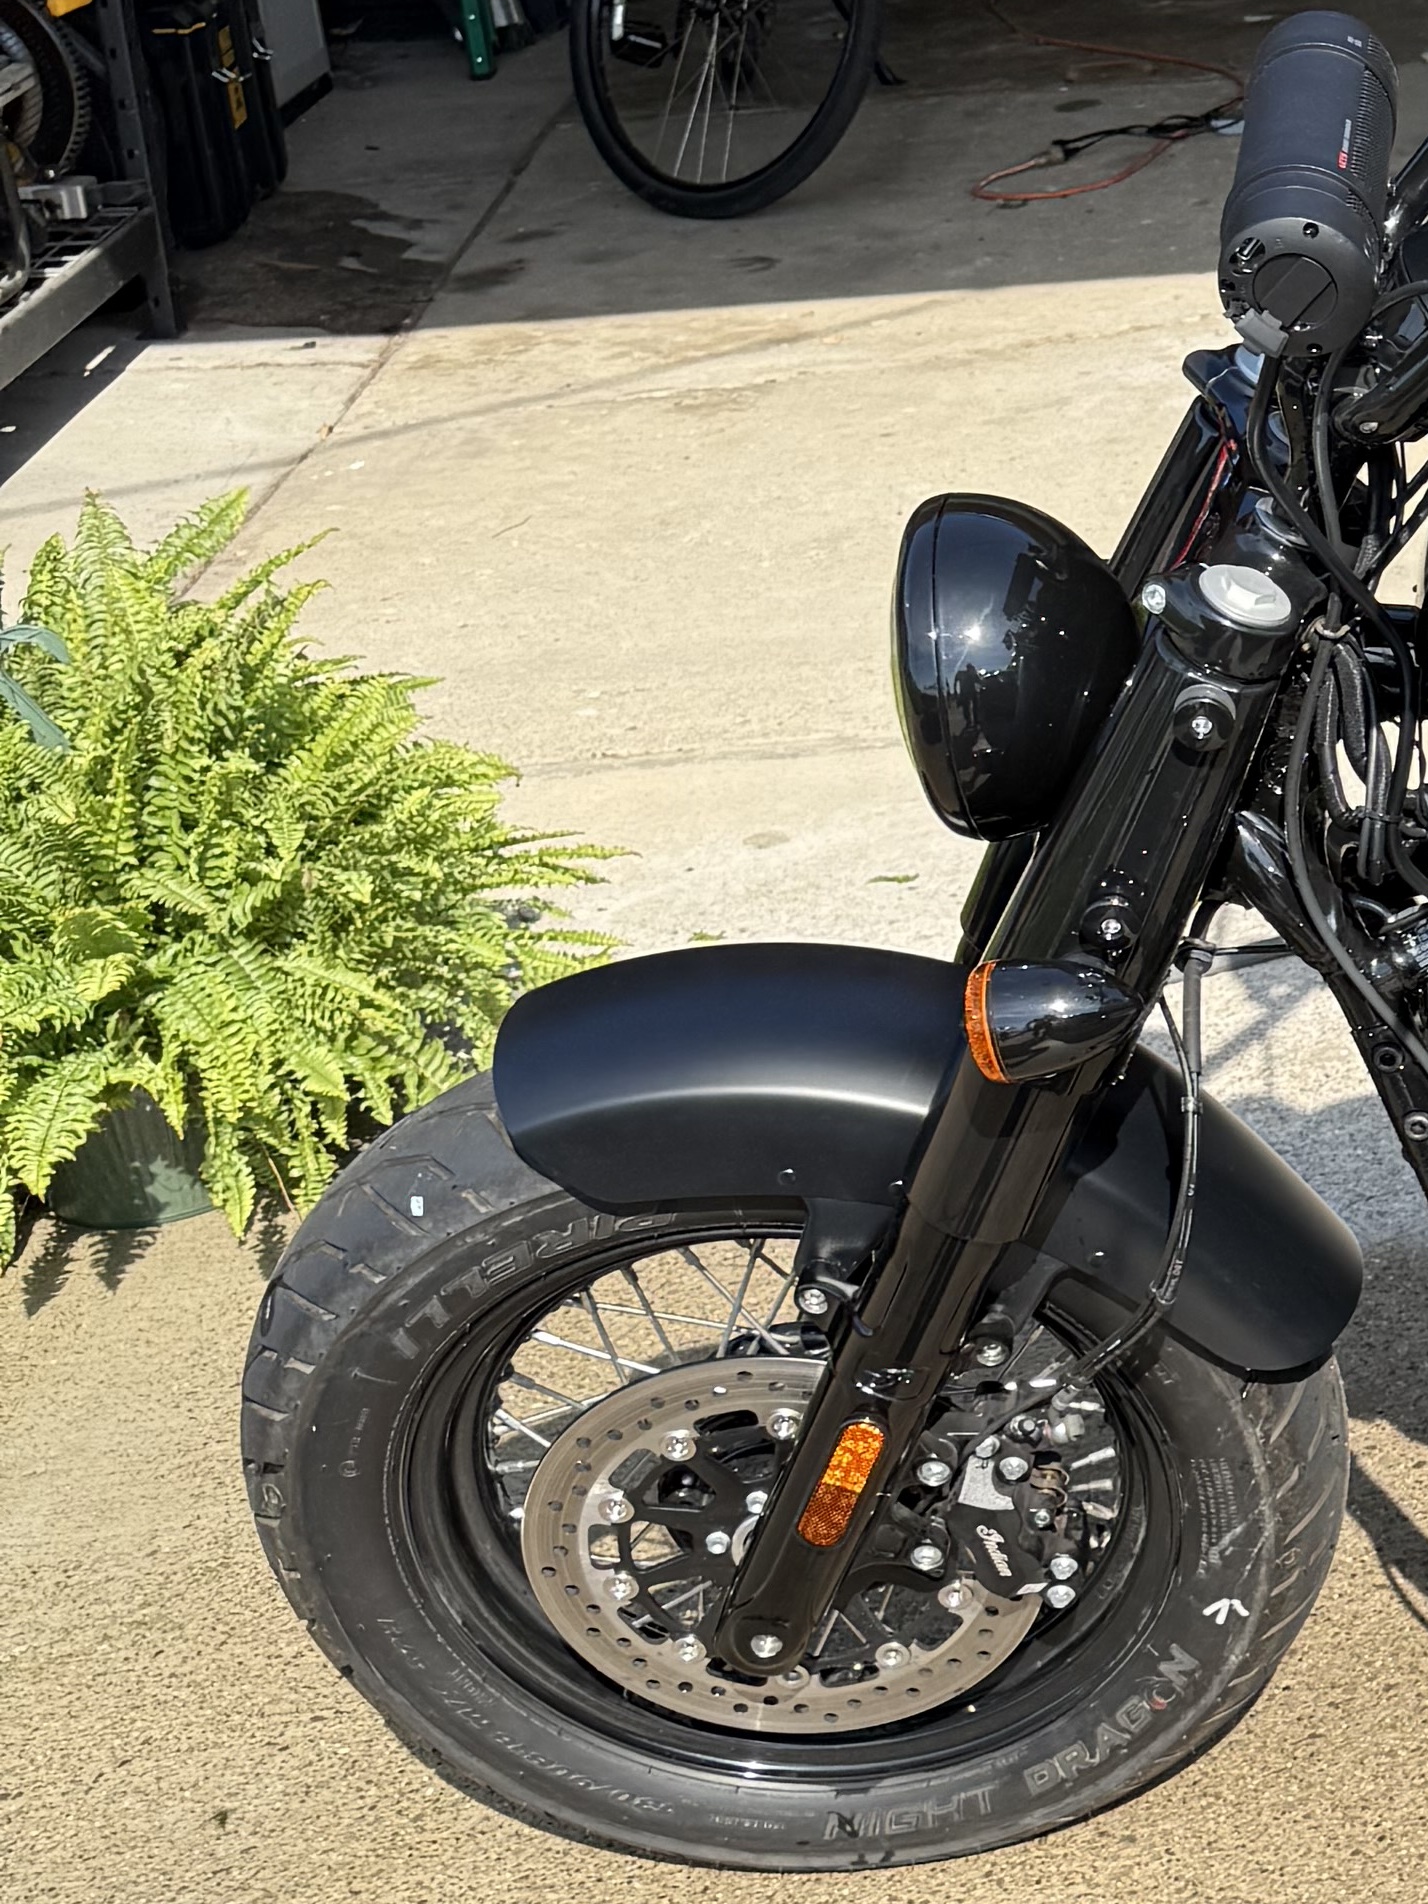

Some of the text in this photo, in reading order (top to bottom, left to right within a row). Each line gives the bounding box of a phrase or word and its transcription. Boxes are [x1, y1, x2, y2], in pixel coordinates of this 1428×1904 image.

[389, 1212, 678, 1360] PIRELLI
[975, 1524, 1013, 1577] Indian
[822, 1643, 1201, 1841] NIGHT DRAGON
